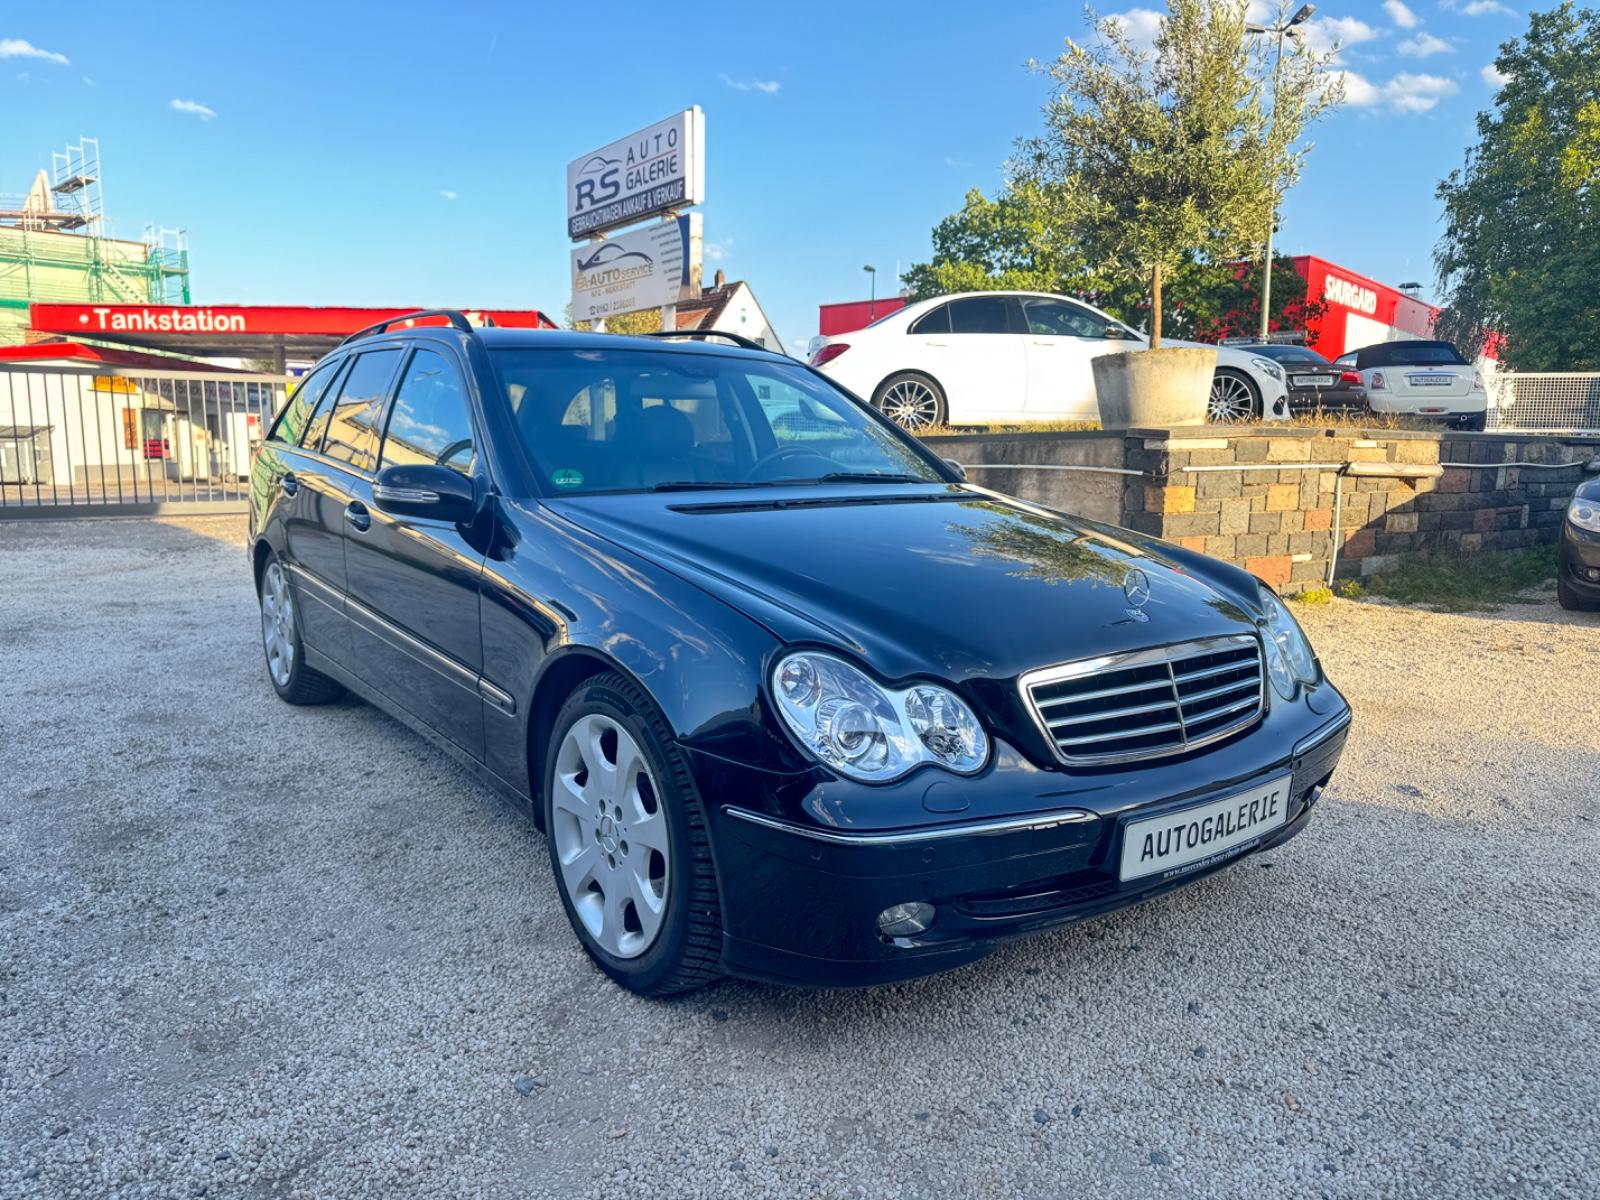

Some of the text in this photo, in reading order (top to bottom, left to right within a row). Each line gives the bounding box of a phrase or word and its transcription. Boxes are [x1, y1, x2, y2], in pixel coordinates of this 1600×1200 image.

[626, 128, 678, 167] AUTO
[575, 167, 621, 212] RS
[625, 153, 678, 190] GALERIE
[571, 201, 622, 234] GEBRAUCHTWAGEN
[622, 193, 647, 217] ANKAUF
[652, 180, 684, 207] VERKAUF
[621, 263, 654, 279] SERVICE
[1325, 274, 1377, 314] SHURGARD
[93, 308, 246, 332] Tankstation
[1140, 790, 1280, 862] AUTOGALERIE
